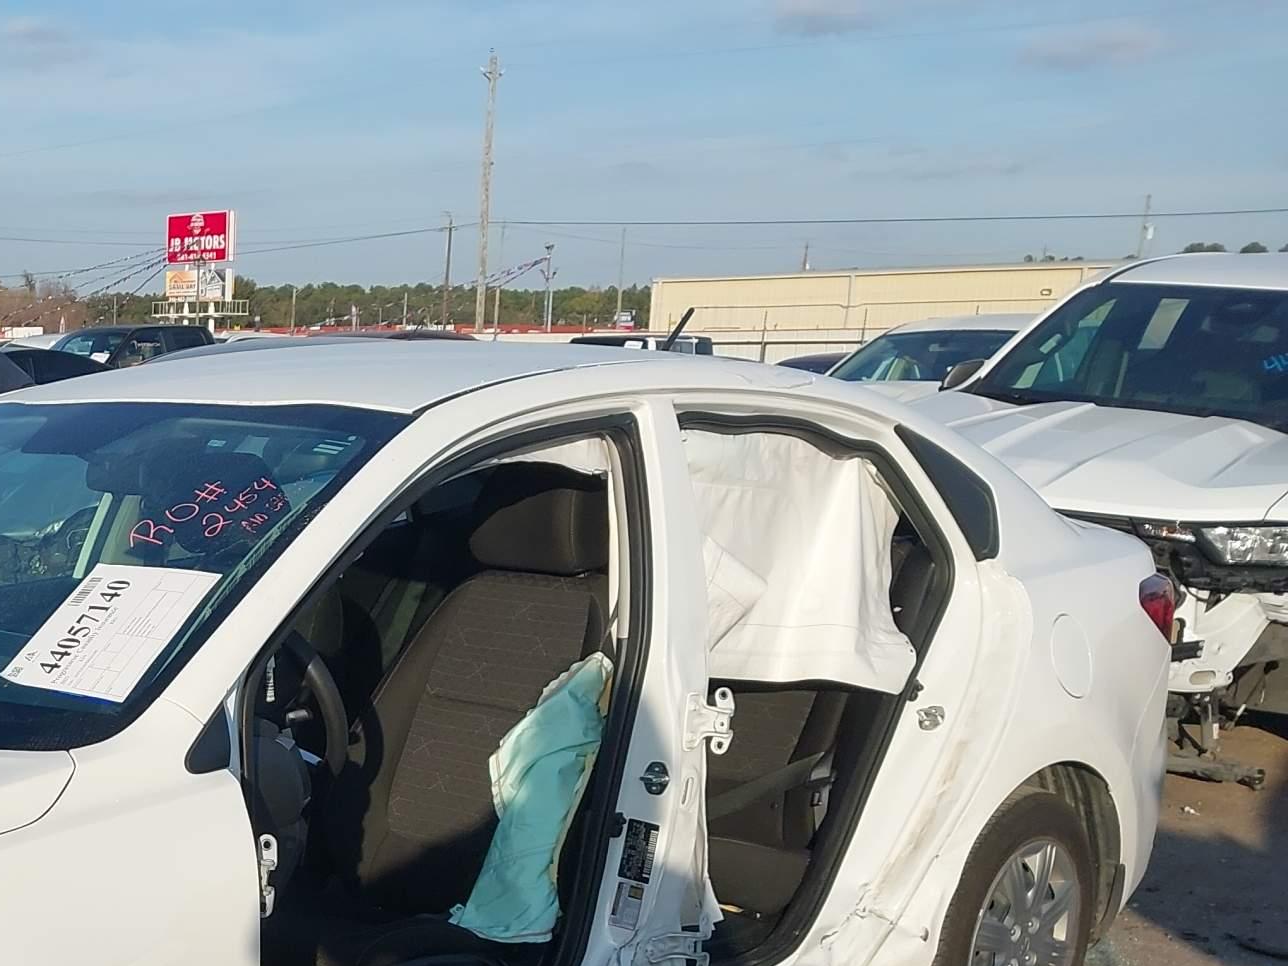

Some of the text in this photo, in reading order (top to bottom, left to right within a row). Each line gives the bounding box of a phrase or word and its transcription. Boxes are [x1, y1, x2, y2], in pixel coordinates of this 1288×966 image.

[169, 234, 225, 252] JB MOTORS
[130, 480, 227, 548] RO#
[202, 477, 277, 537] 2454
[39, 579, 131, 674] 44057140
